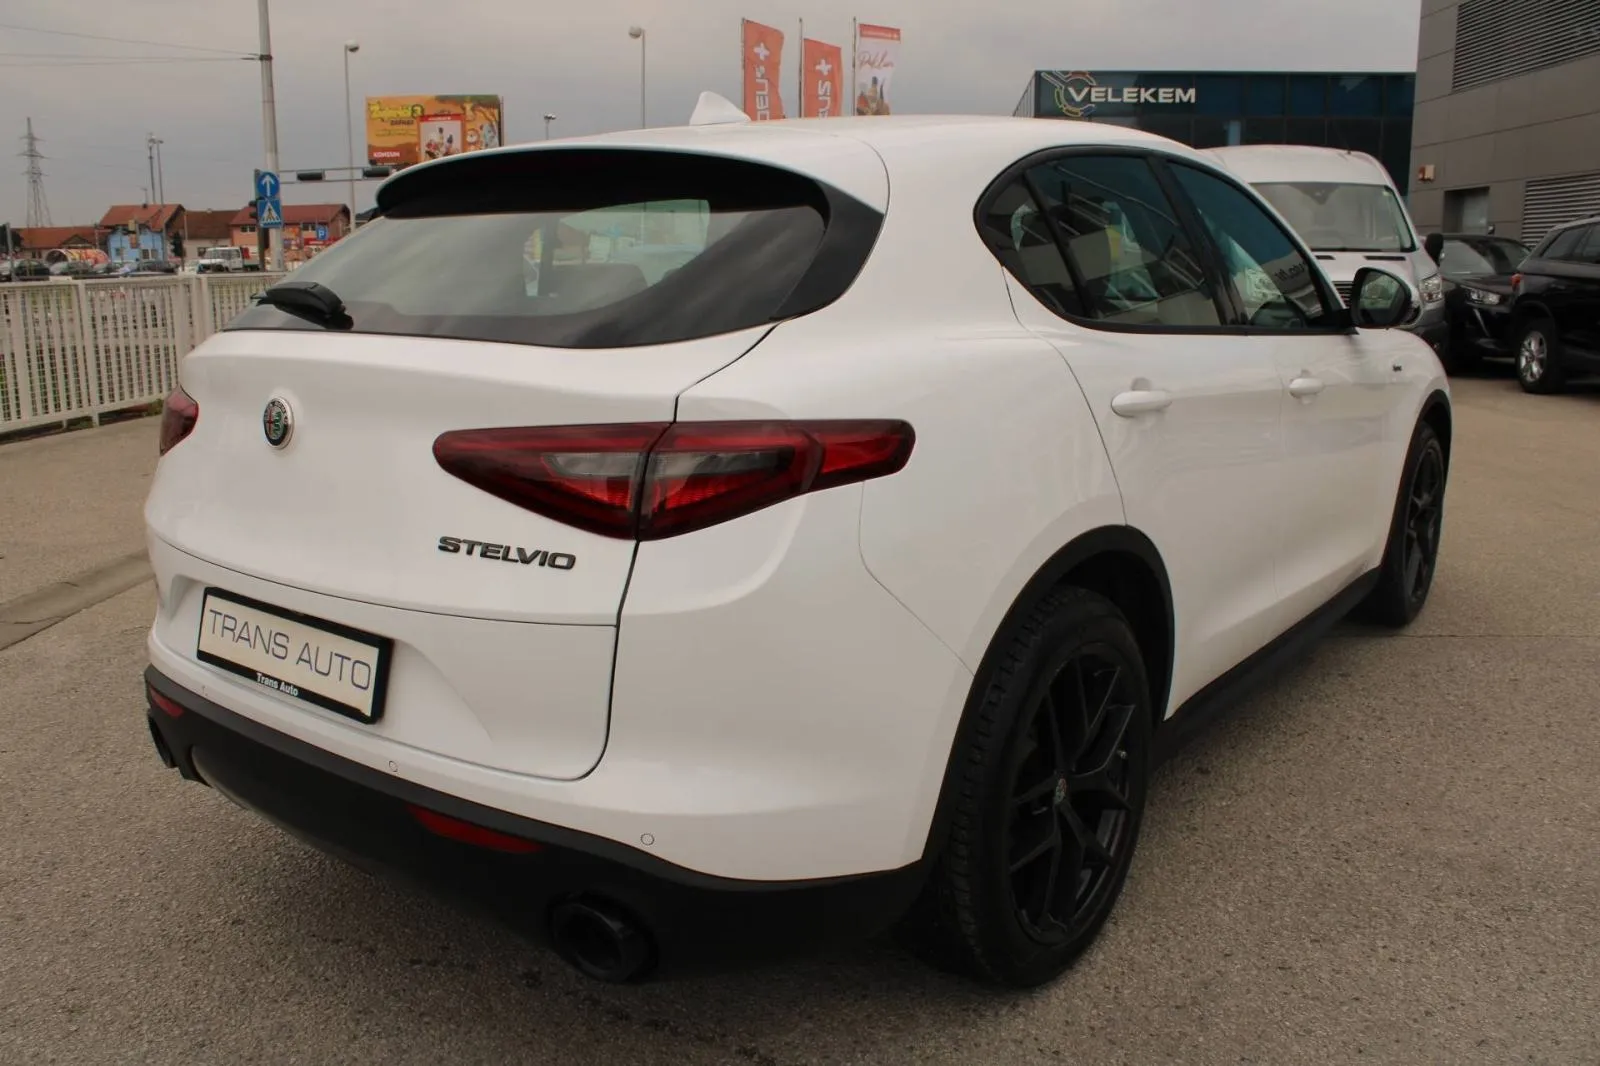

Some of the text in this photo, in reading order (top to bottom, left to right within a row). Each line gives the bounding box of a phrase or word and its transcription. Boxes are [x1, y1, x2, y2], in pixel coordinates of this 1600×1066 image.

[1067, 87, 1196, 104] VELEKEM
[438, 536, 576, 570] STELVIO
[209, 609, 371, 690] TRANS AUTO
[256, 672, 298, 697] Trans Auto
